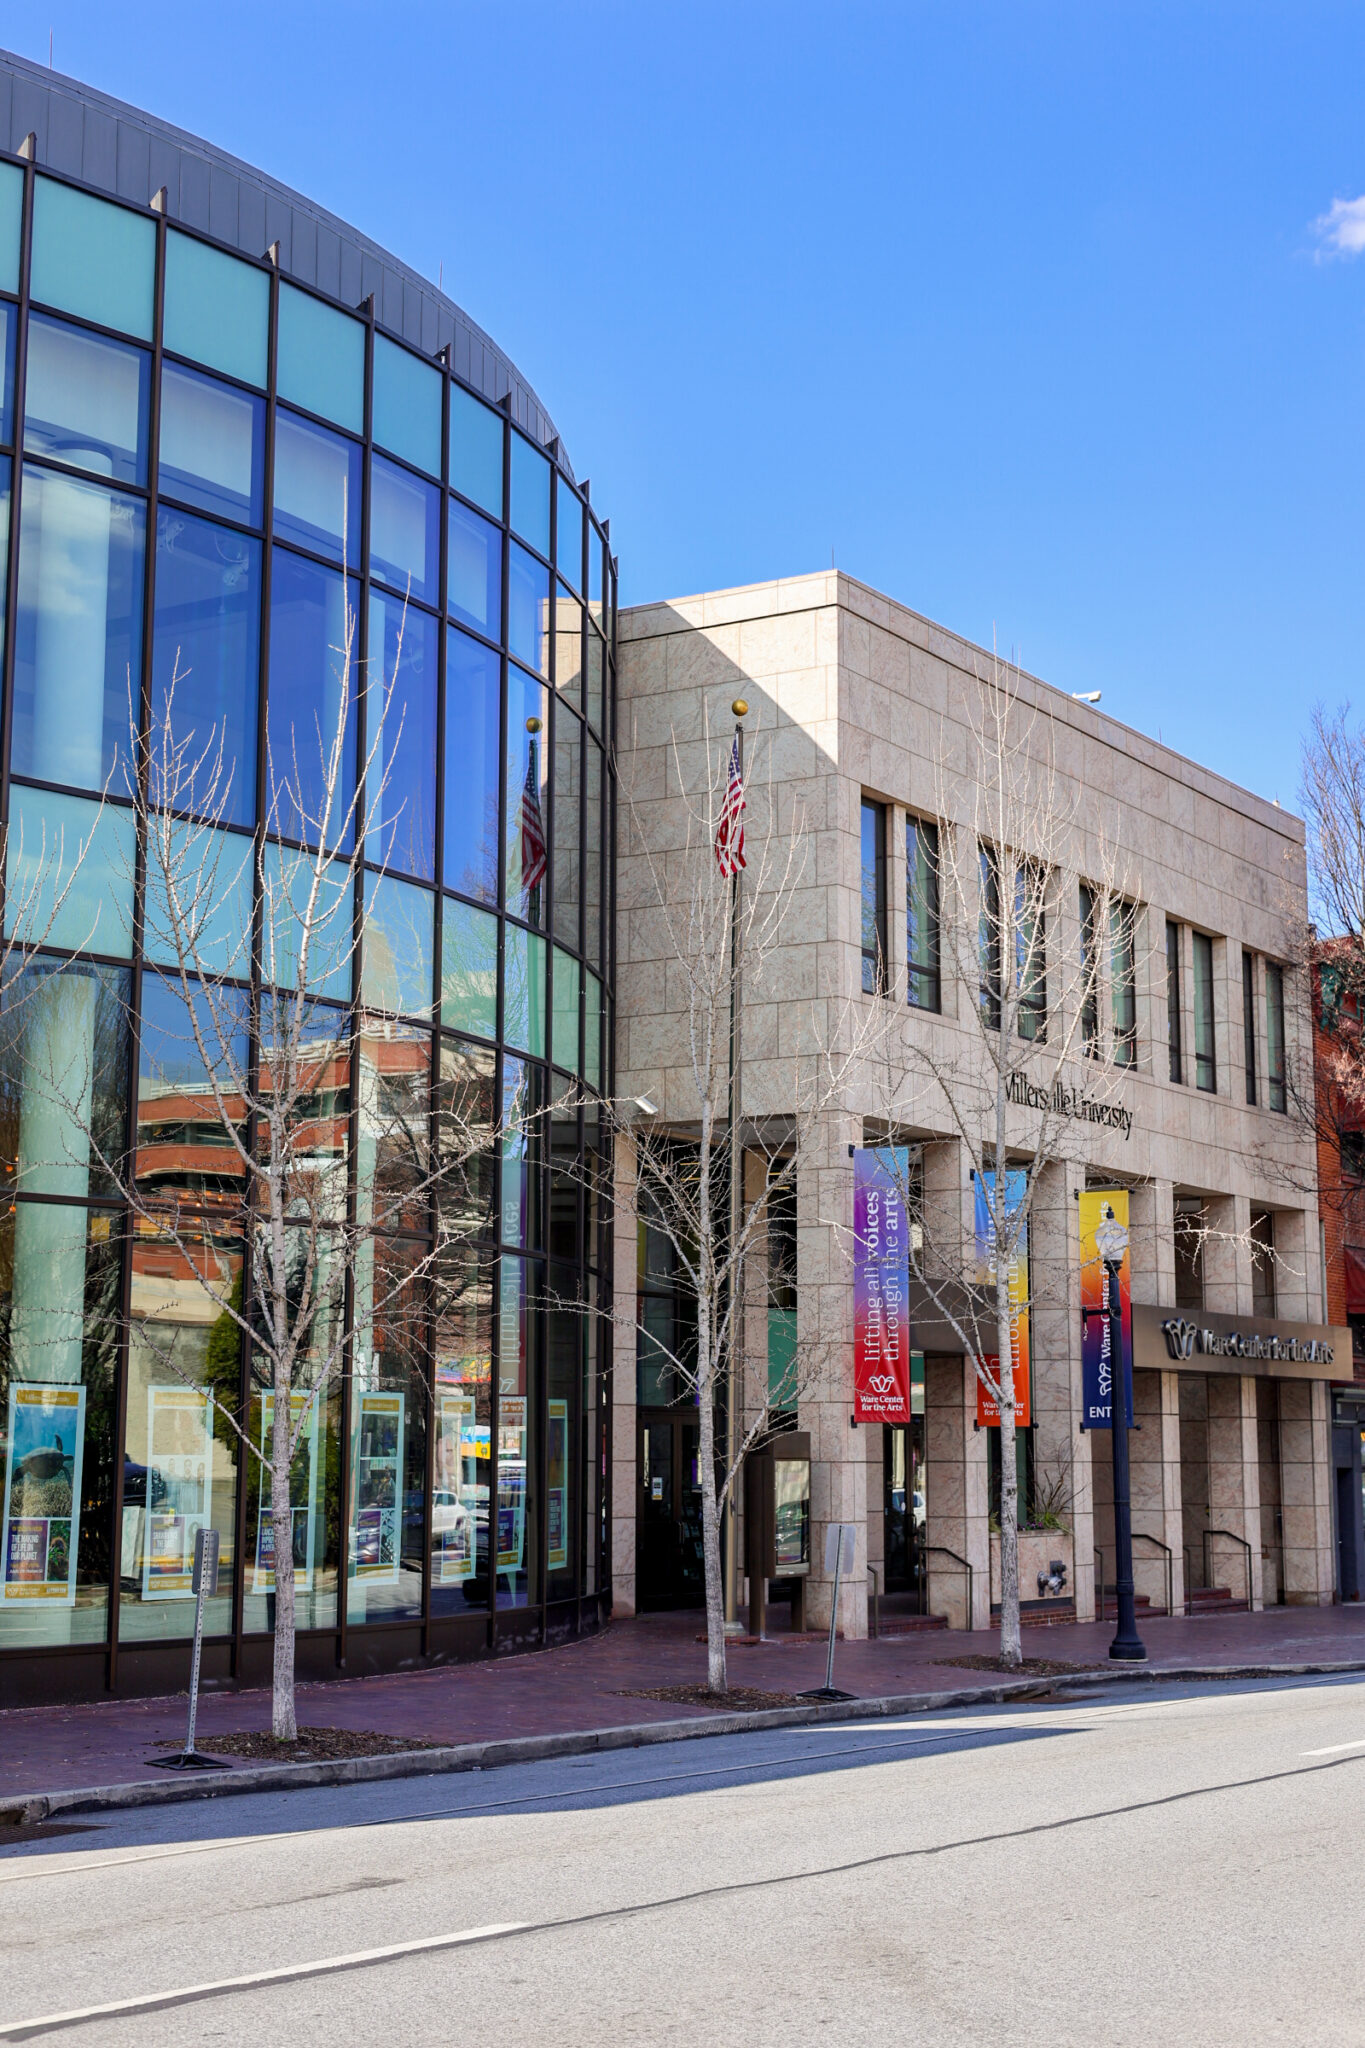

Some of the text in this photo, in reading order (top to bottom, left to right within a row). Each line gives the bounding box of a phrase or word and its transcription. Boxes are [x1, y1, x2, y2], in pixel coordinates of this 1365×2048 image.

[1005, 1071, 1071, 1117] Millersille
[863, 1191, 883, 1362] lifting all voices
[883, 1187, 902, 1362] through the arts
[1101, 1323, 1111, 1359] Ware
[1197, 1329, 1335, 1364] Ware Center for the Arts
[860, 1395, 905, 1403] Ware Center
[887, 1404, 903, 1412] Arts
[21, 1551, 37, 1560] PLANET
